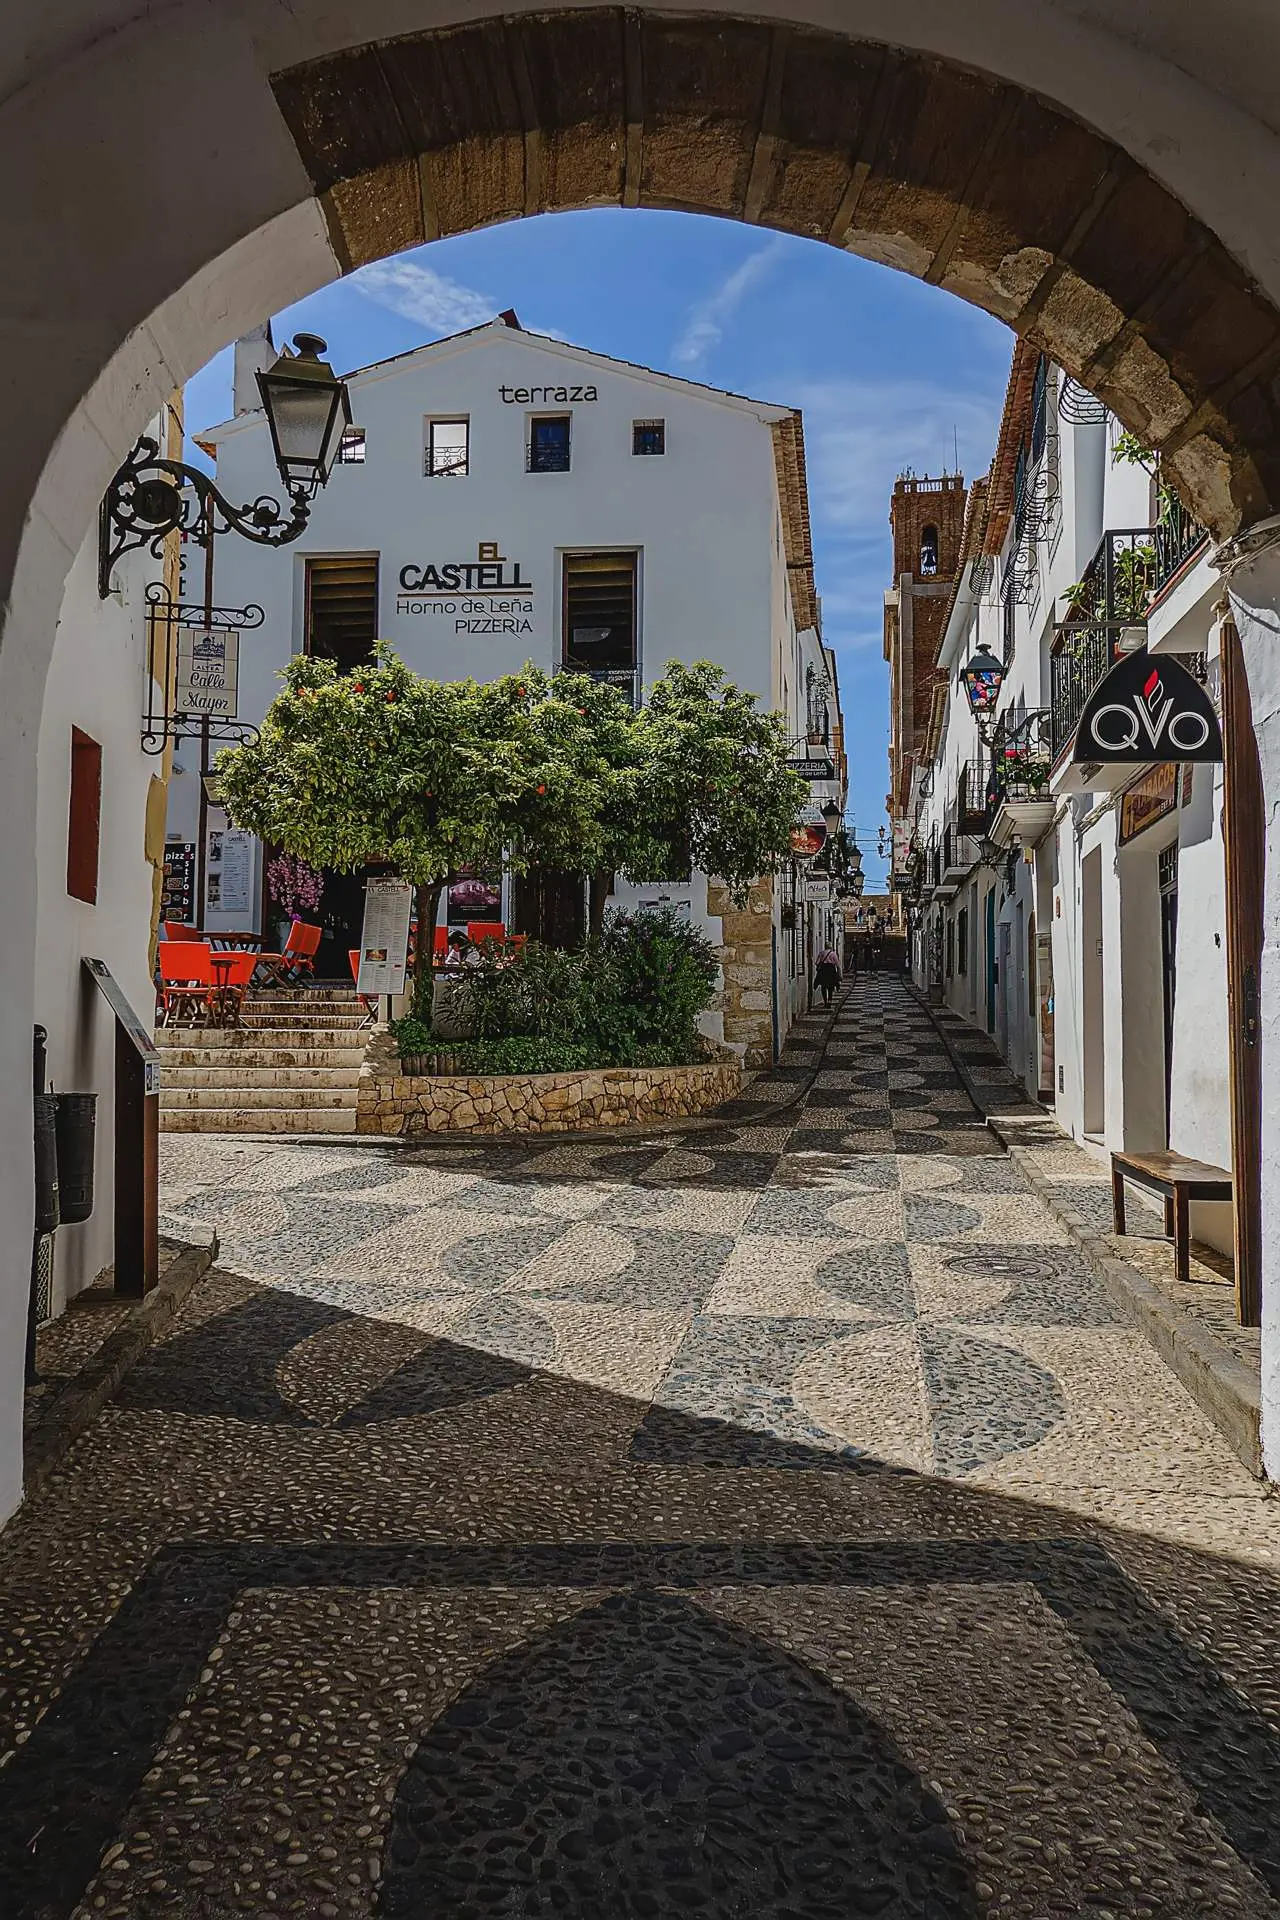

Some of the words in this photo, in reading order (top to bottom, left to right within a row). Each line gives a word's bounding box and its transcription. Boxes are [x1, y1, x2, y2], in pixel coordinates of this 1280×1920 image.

[499, 384, 598, 404] terraza
[478, 542, 507, 562] EL
[399, 563, 532, 590] CASTELL
[396, 600, 456, 614] Horno
[461, 599, 484, 613] de
[490, 598, 533, 613] Leña
[455, 619, 533, 634] PIZZERIA
[190, 672, 225, 688] Calle
[182, 691, 228, 715] Mayor
[1090, 695, 1209, 751] QVO
[786, 762, 827, 770] PIZZERIA
